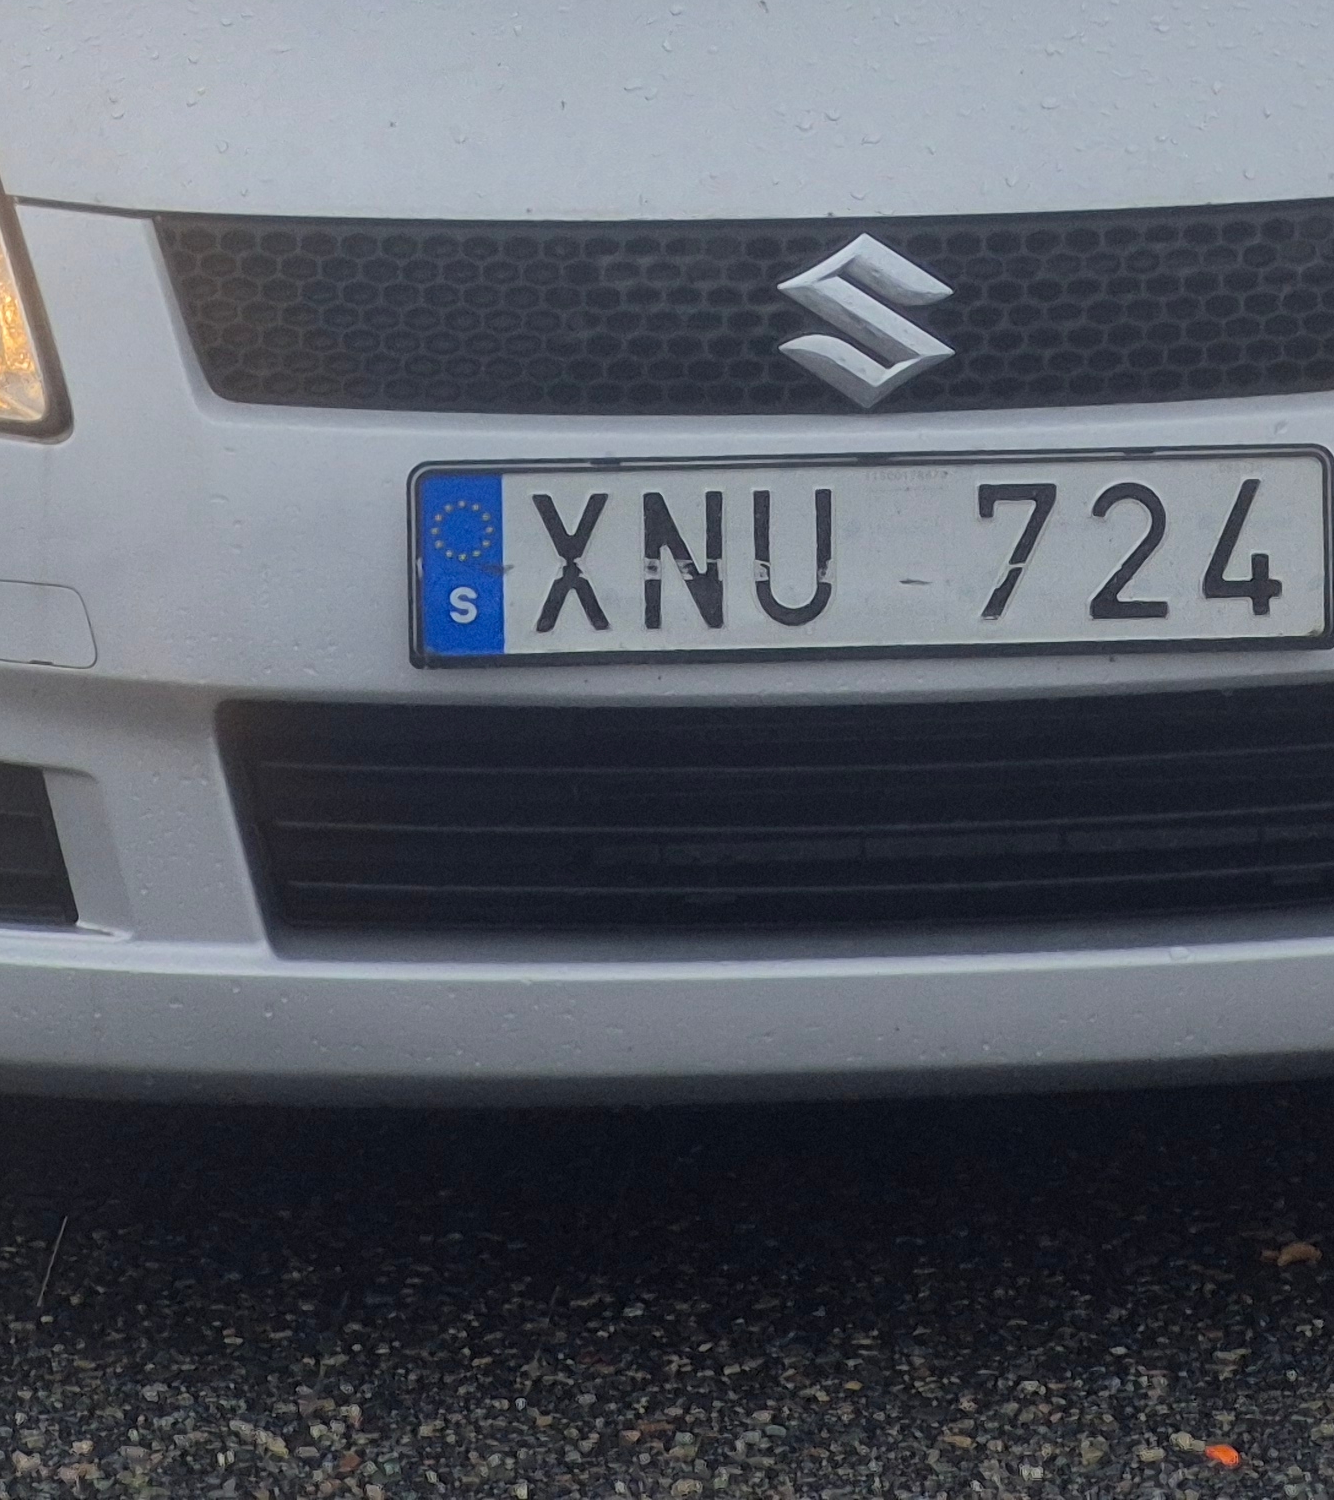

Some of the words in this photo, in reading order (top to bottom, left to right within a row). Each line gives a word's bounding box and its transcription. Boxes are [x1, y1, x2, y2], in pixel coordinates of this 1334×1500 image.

[532, 488, 833, 633] XNU
[977, 478, 1283, 621] 724
[449, 586, 478, 624] S
